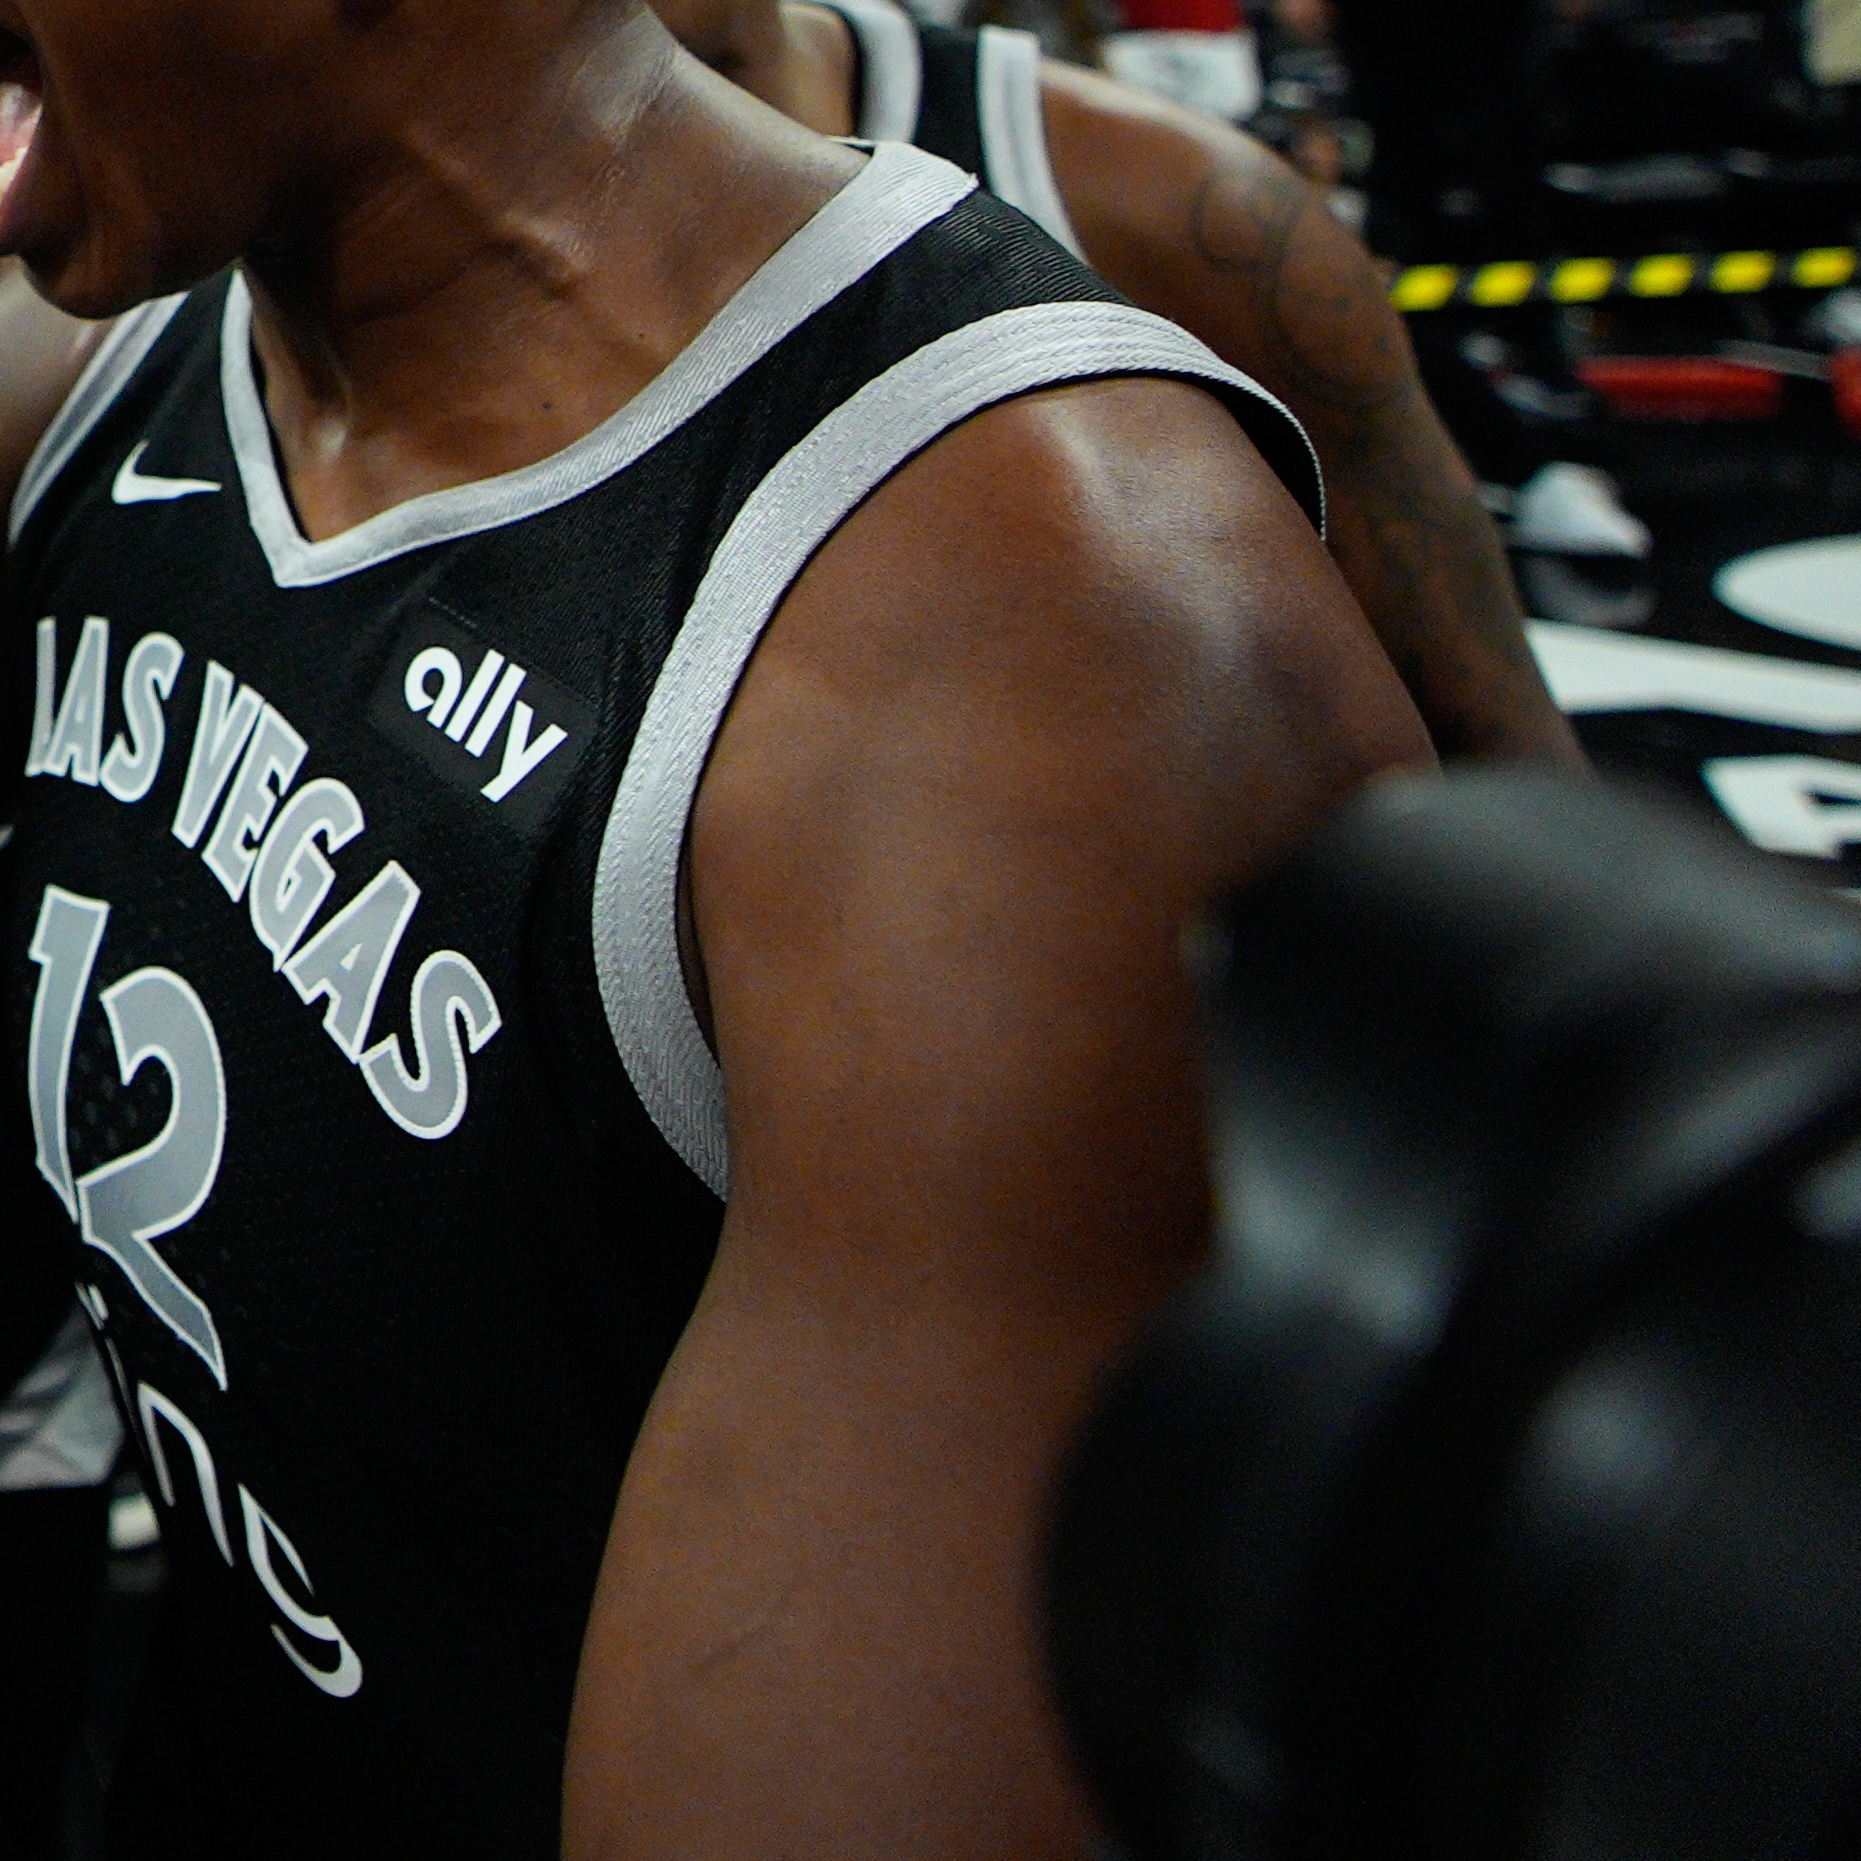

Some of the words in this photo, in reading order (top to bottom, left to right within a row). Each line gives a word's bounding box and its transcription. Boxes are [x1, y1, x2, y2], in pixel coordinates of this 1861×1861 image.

[171, 658, 503, 1141] VEGAS
[403, 645, 569, 803] ally
[27, 883, 230, 1393] 12
